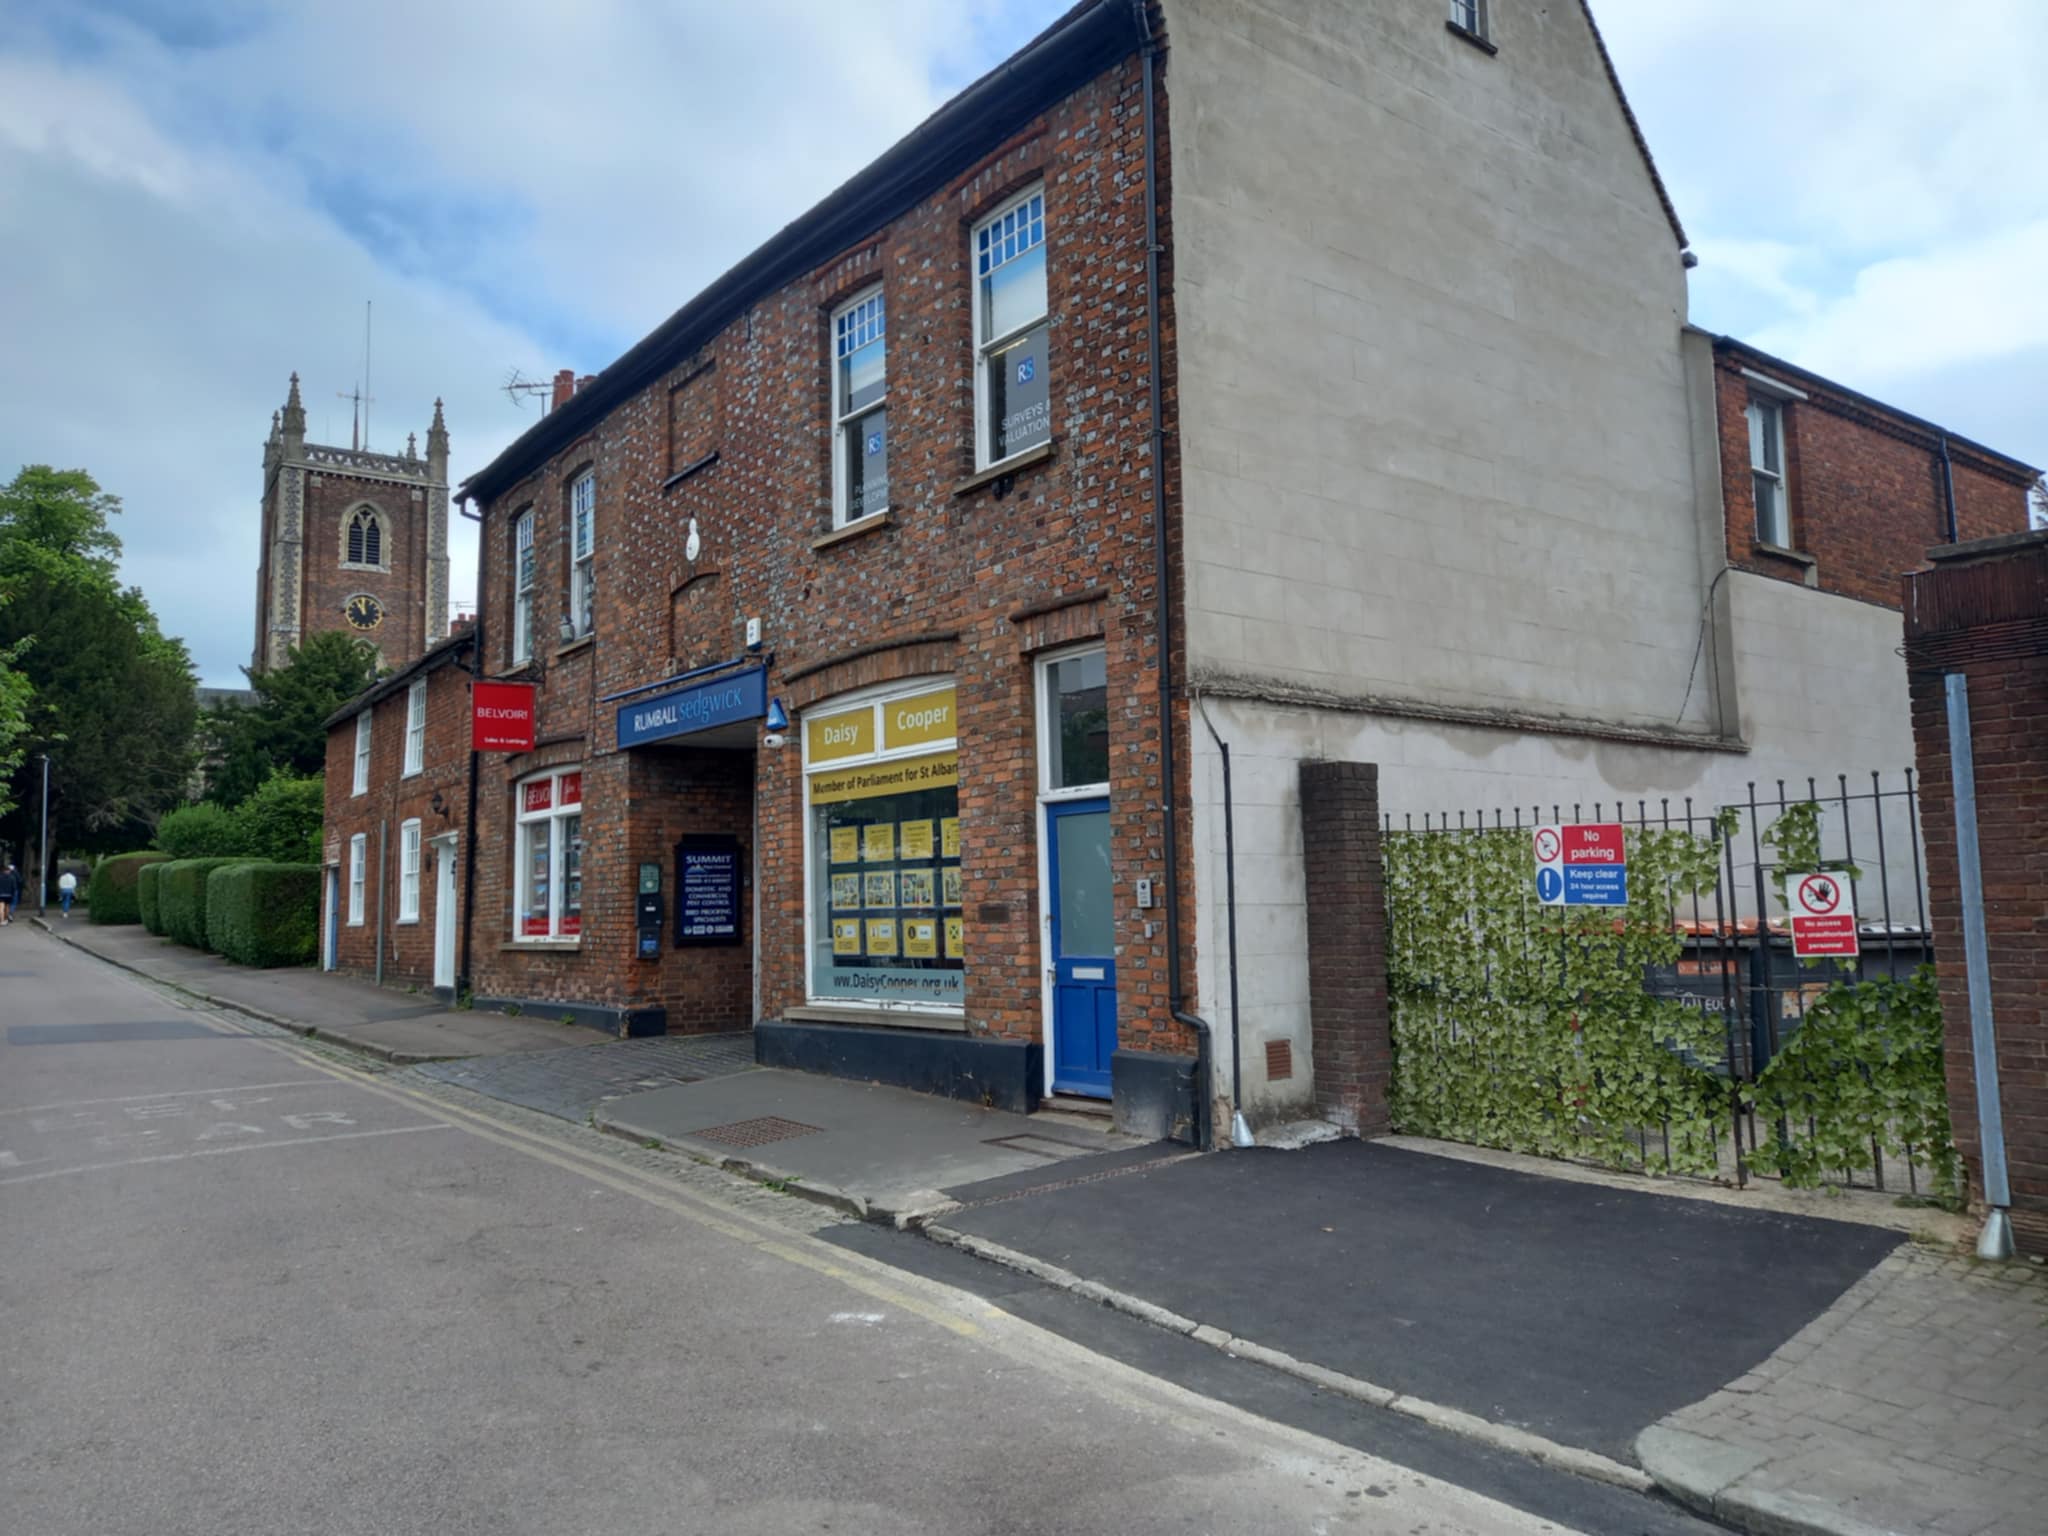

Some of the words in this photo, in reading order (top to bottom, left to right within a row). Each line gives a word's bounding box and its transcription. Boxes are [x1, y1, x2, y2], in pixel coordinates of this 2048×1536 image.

[633, 704, 678, 732] RUMBALL
[824, 723, 858, 746] Daisy
[897, 705, 949, 731] Cooper
[813, 780, 845, 794] Member
[847, 777, 855, 790] of
[857, 773, 903, 789] Parliament
[905, 769, 918, 782] for
[920, 766, 930, 779] St
[1583, 830, 1600, 842] No
[686, 855, 732, 864] SUMMIT
[1571, 847, 1615, 861] parking
[1570, 869, 1593, 880] Keep
[1595, 869, 1618, 879] clear
[1582, 892, 1608, 900] required
